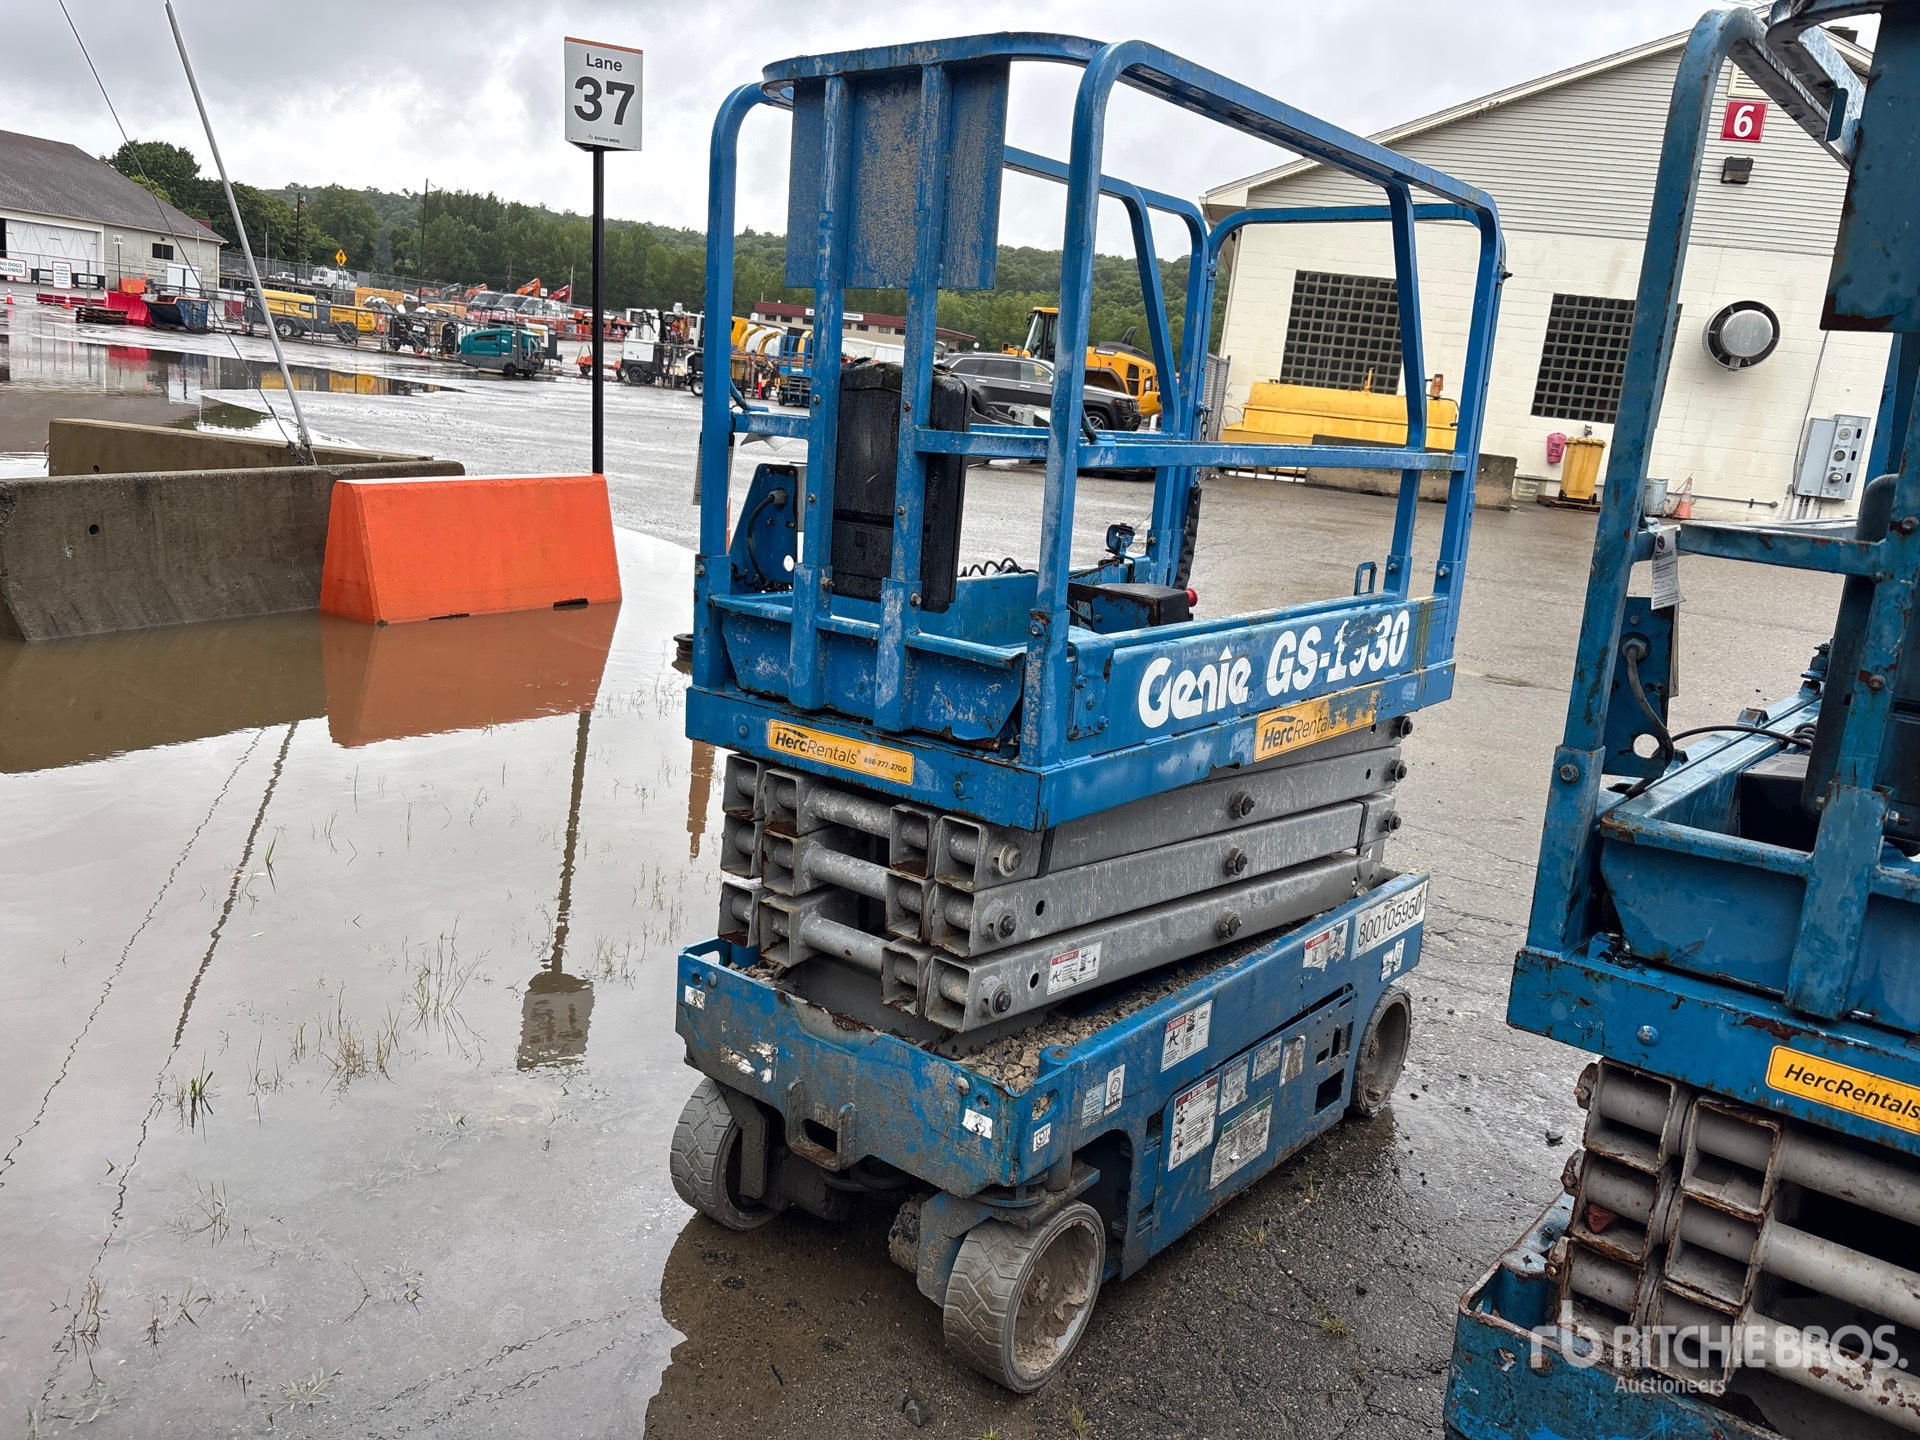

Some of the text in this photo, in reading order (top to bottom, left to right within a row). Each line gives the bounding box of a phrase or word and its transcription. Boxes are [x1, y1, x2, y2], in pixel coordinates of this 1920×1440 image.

[586, 53, 623, 71] Lane
[574, 76, 635, 125] 37
[1733, 105, 1755, 137] 6
[1138, 646, 1252, 728] Genie
[1358, 894, 1422, 947] 800105950
[1784, 1063, 1920, 1118] HercRentals
